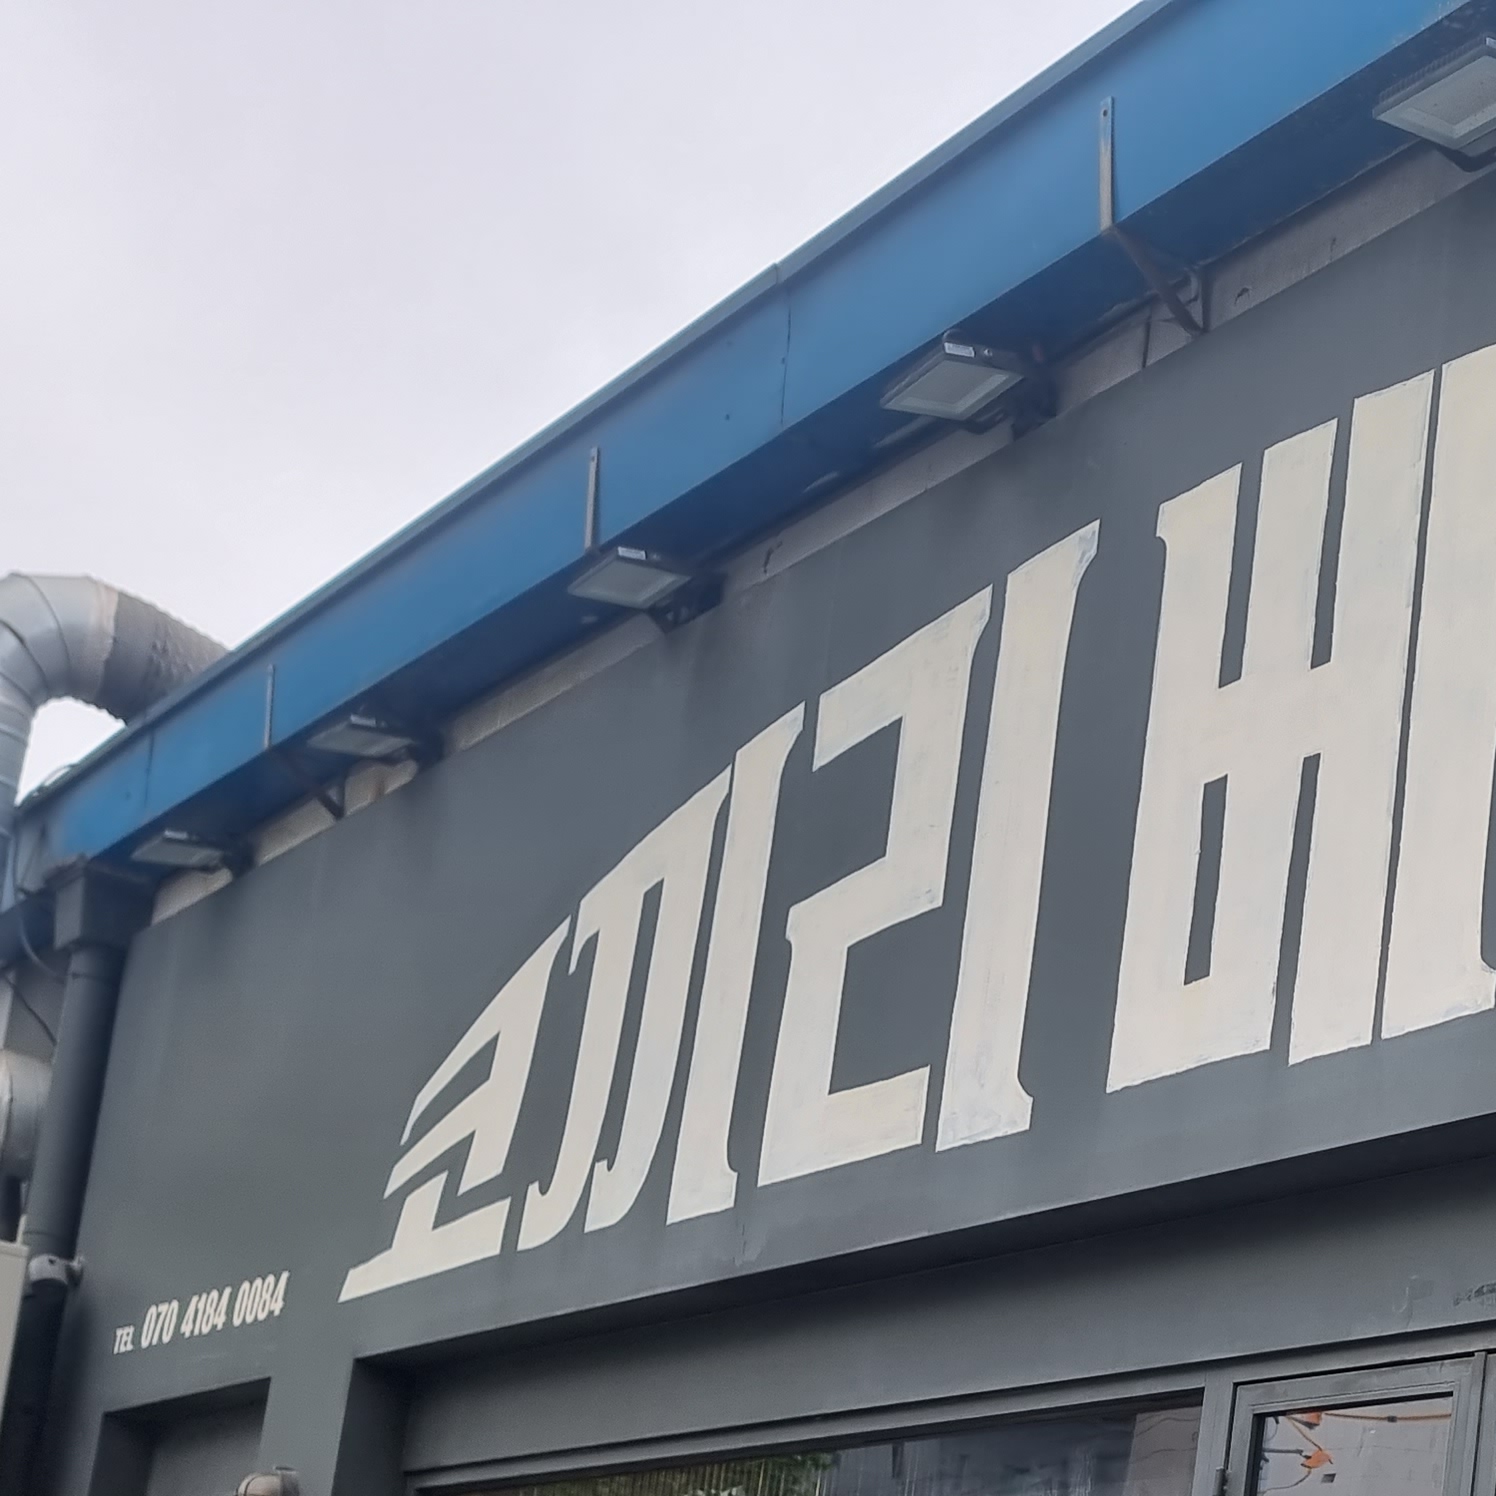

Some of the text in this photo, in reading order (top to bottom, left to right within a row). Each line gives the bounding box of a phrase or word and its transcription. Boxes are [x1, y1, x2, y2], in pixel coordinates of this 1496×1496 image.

[341, 522, 1101, 1303] 코끼리
[113, 1270, 290, 1355] TEL 070 4184 0084
